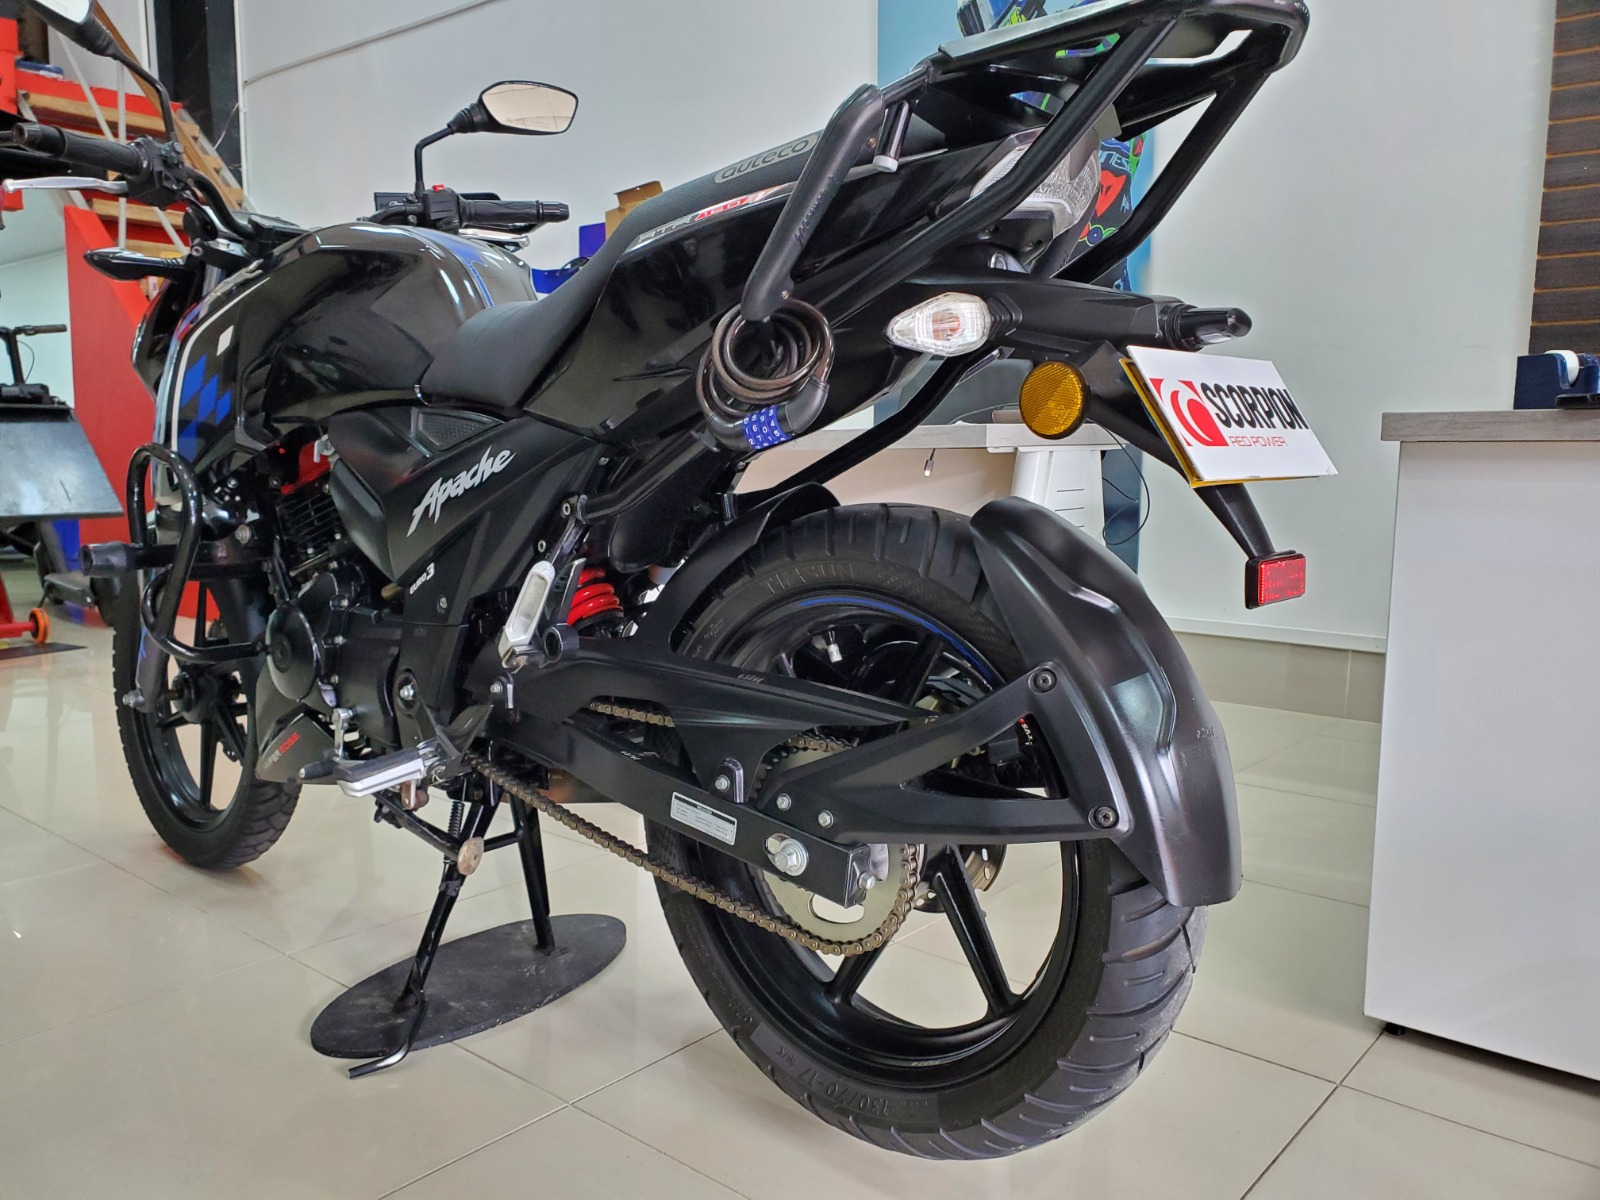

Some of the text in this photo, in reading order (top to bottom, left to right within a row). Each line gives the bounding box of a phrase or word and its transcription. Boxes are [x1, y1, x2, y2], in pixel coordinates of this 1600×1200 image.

[720, 139, 809, 179] auteco
[1200, 382, 1310, 430] SCORPION
[1228, 435, 1287, 447] RED POWER
[406, 444, 517, 538] Apache
[409, 562, 435, 595] EURO 3
